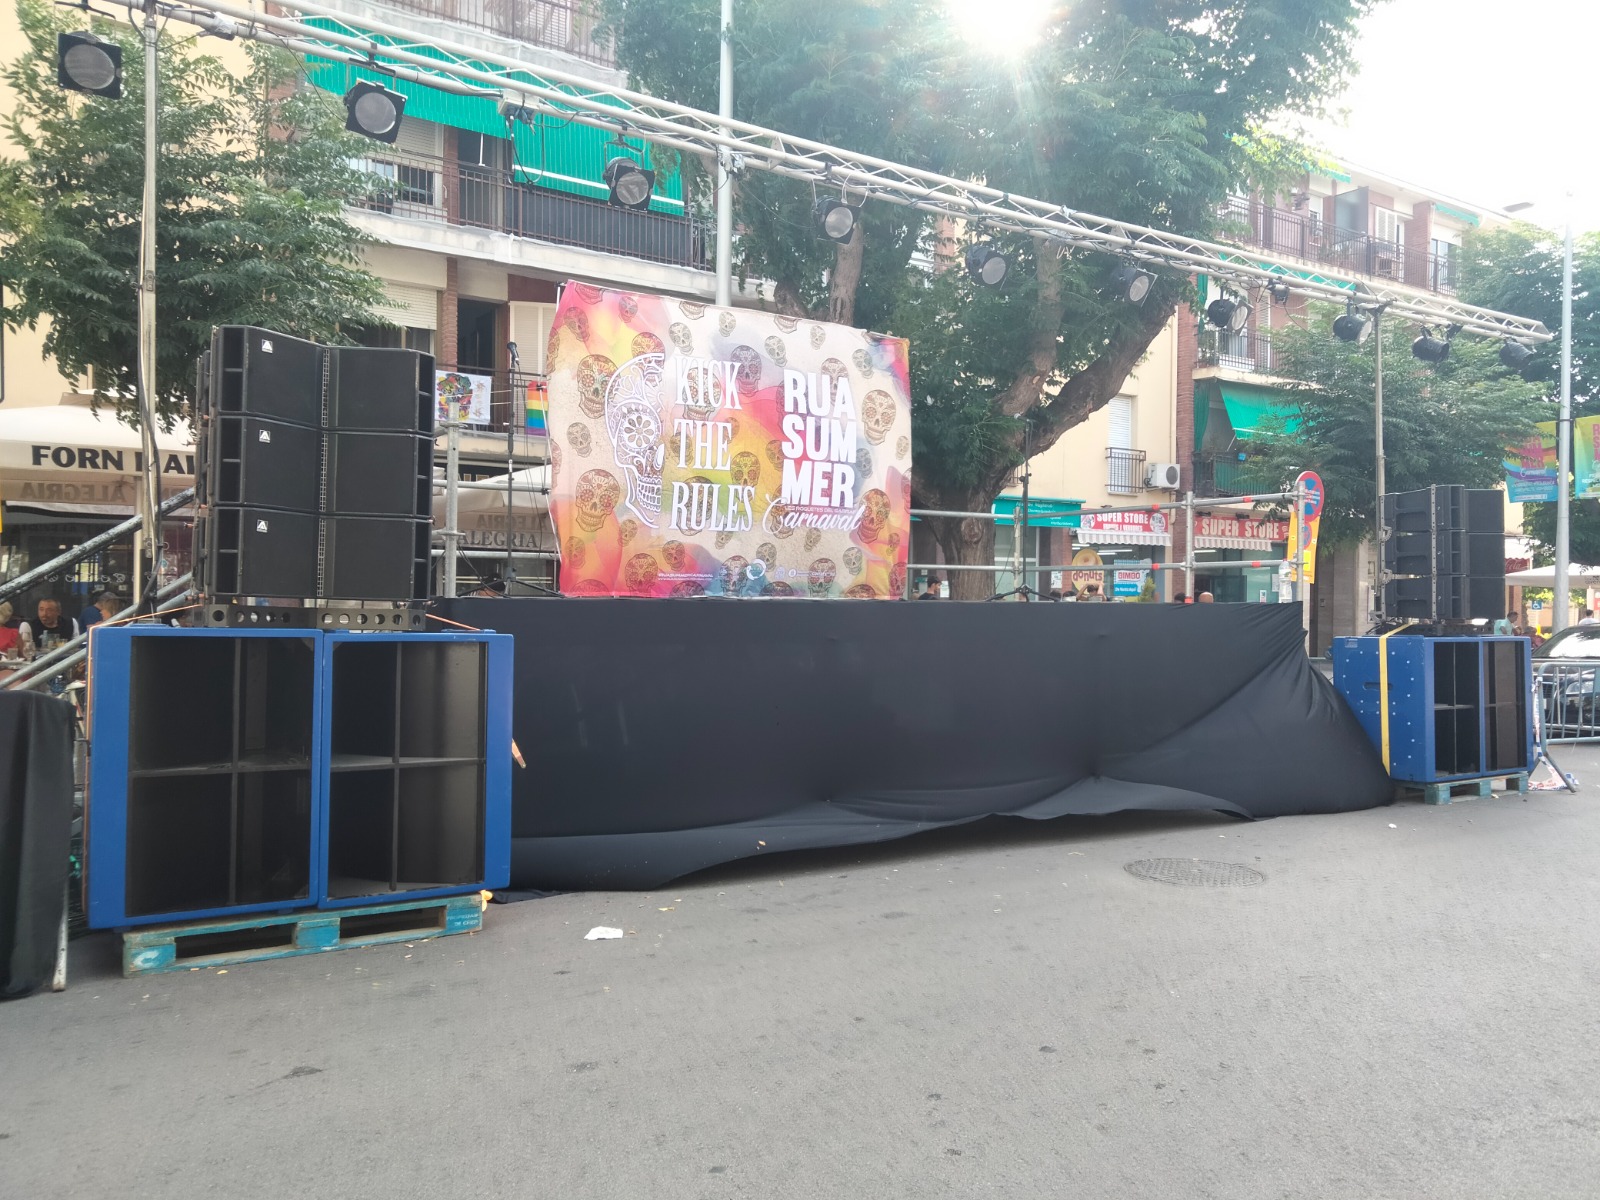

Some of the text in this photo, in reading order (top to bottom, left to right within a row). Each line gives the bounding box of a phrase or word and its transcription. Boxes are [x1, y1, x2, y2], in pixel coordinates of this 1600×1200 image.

[674, 356, 742, 410] KICK
[783, 369, 856, 420] RUA
[32, 445, 124, 471] FORN
[673, 418, 732, 471] THE
[781, 413, 857, 463] SUM
[781, 458, 856, 509] MER
[669, 481, 756, 533] RULES
[762, 493, 866, 534] Carnaval
[1096, 512, 1149, 524] SUPER STORE
[457, 530, 538, 548] ALEGRIA
[1202, 518, 1239, 536] SUPER
[1245, 521, 1279, 539] STORE
[1073, 569, 1102, 581] donuts
[1118, 571, 1140, 579] BIMBO
